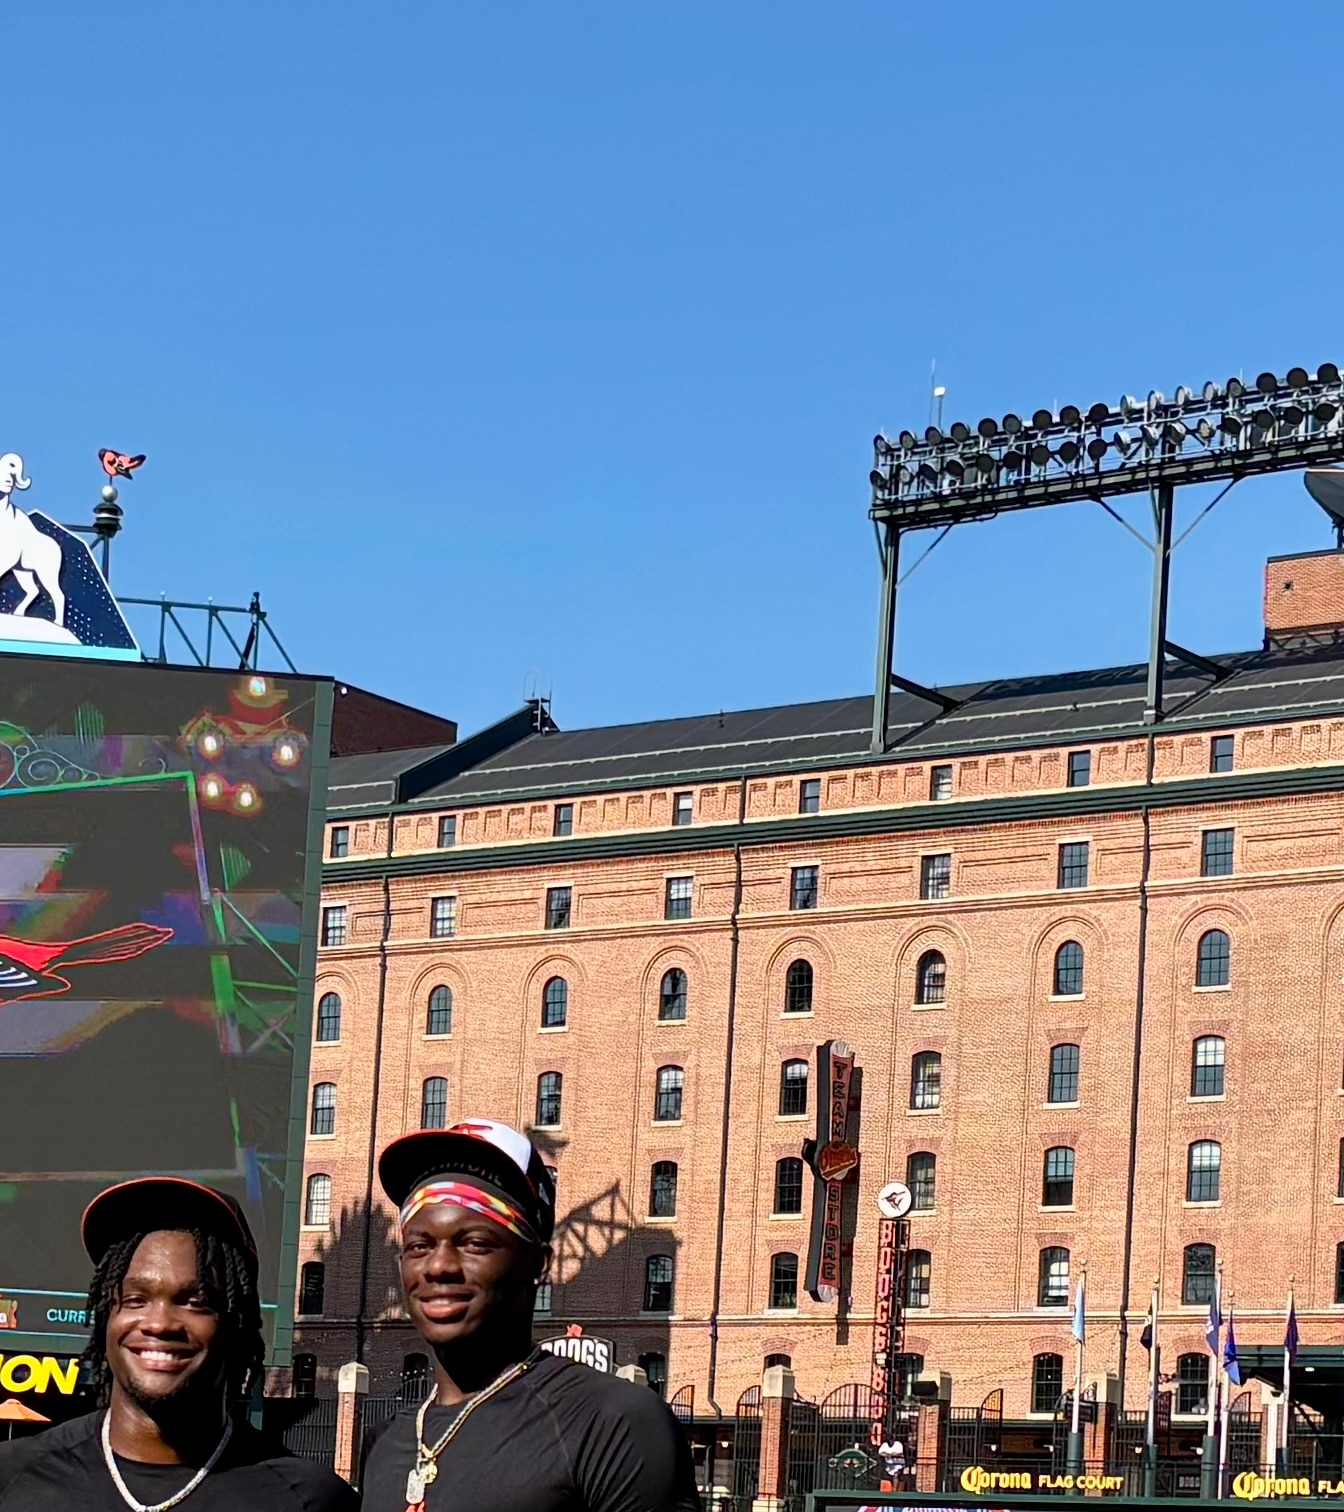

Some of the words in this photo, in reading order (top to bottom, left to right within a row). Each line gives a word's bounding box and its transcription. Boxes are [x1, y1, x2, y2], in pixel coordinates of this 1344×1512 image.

[961, 1466, 1031, 1494] Corona
[1039, 1475, 1073, 1488] FLAG
[1076, 1475, 1124, 1490] COURT
[1232, 1472, 1310, 1501] Corona
